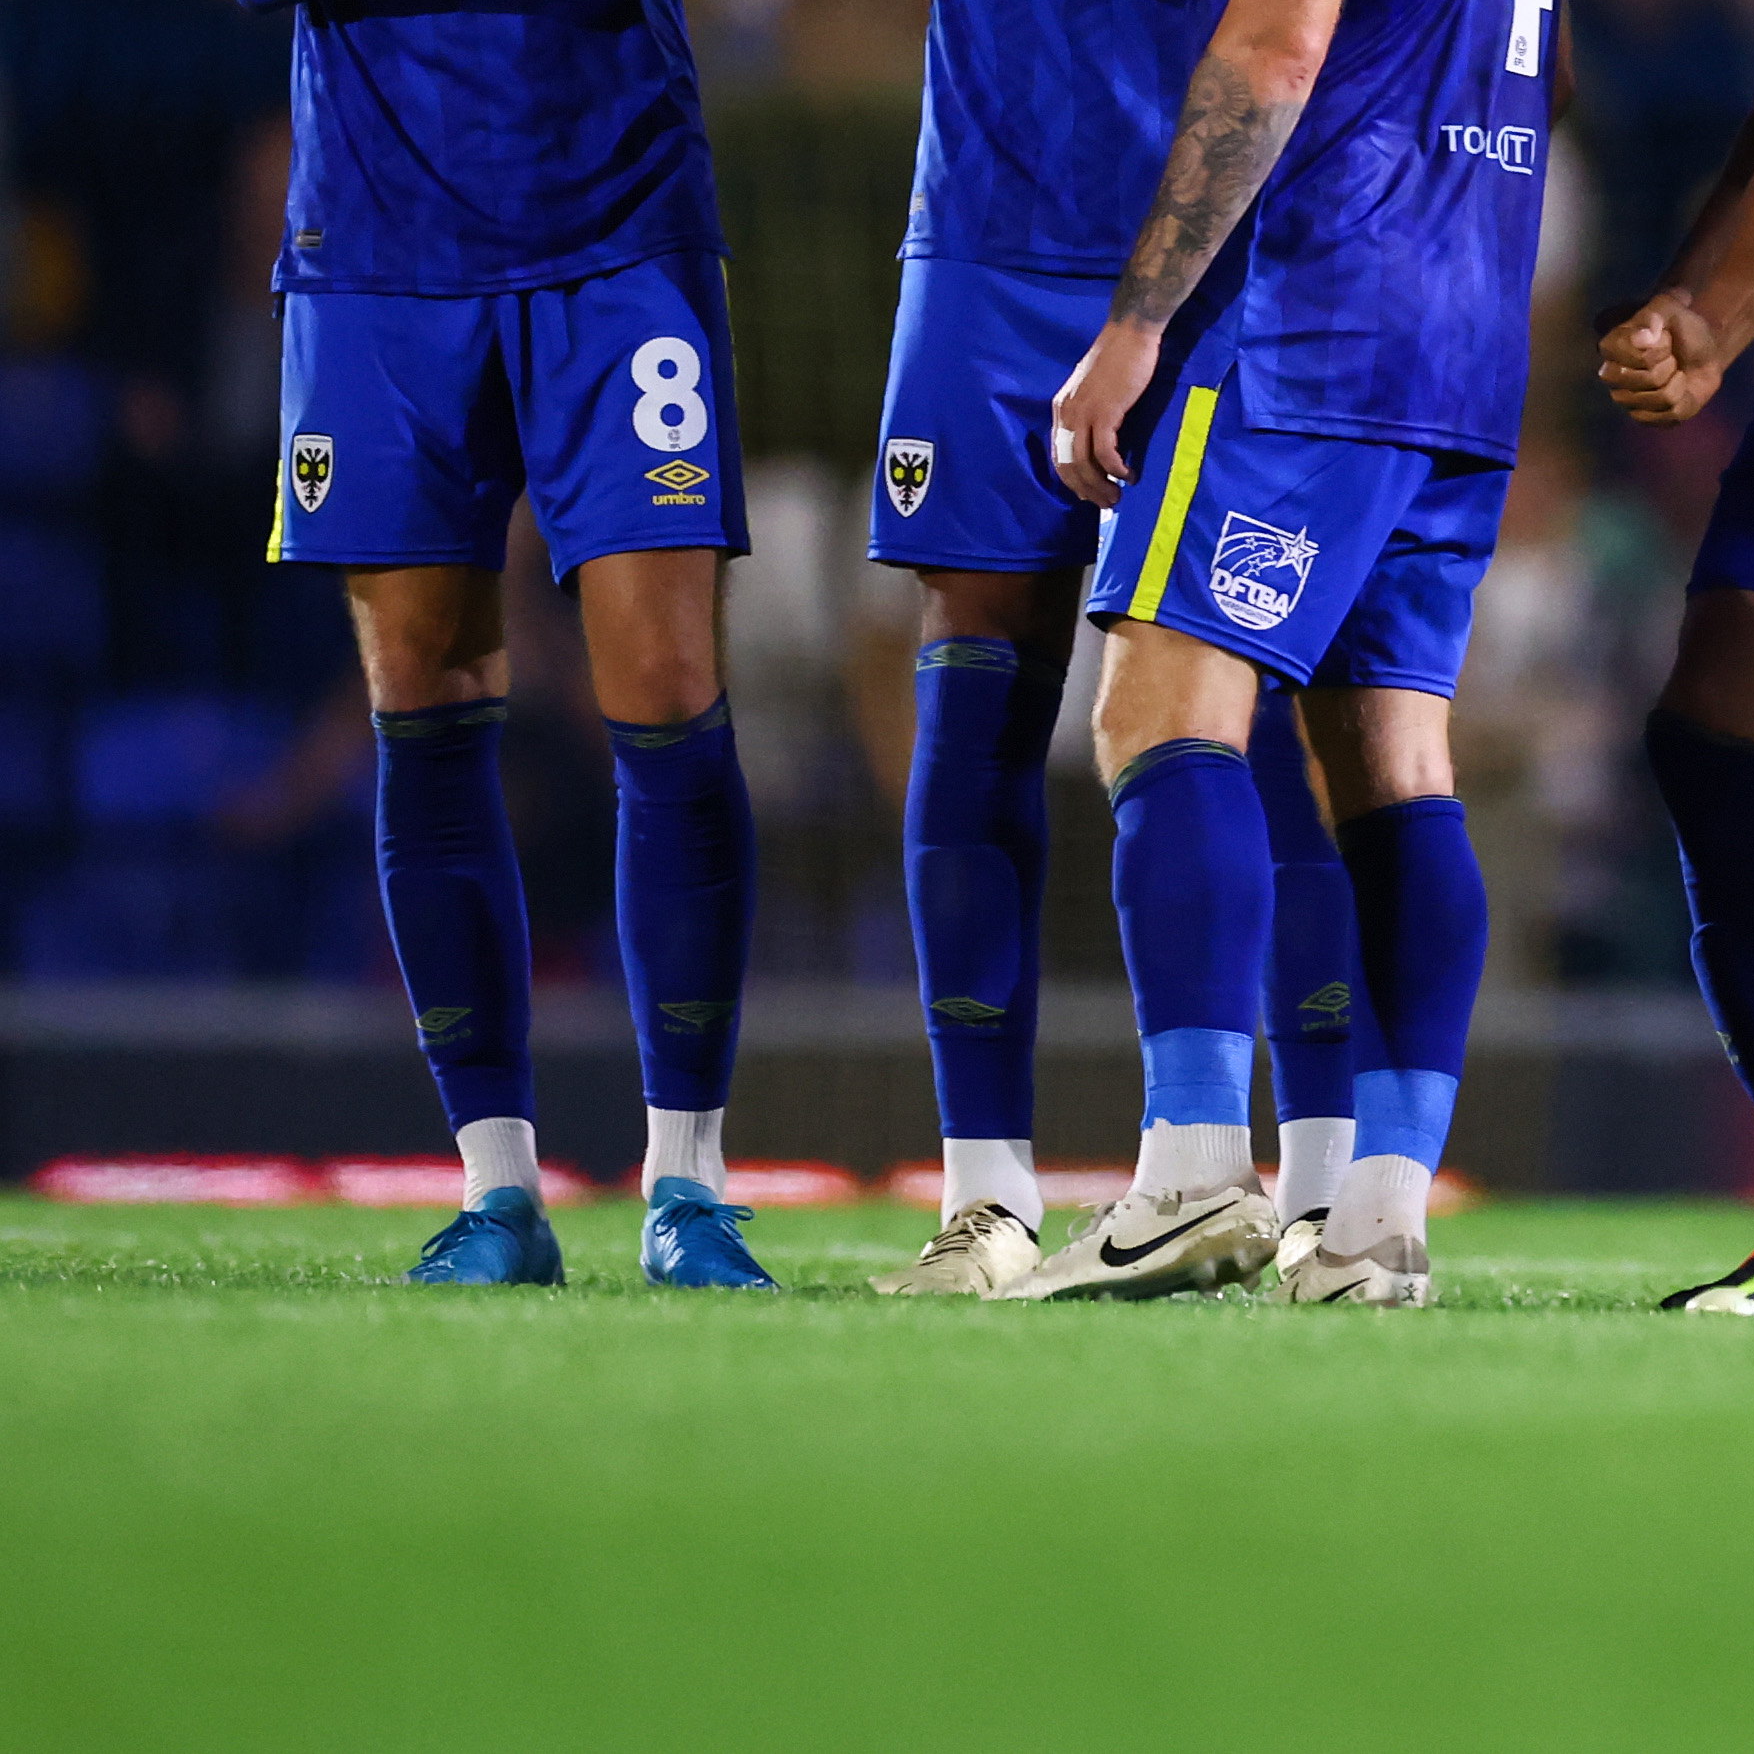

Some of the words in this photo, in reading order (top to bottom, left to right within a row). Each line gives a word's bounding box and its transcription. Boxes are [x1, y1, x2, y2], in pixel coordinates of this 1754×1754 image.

[631, 336, 709, 452] 8
[652, 491, 706, 505] umbro
[1208, 566, 1290, 619] DFTBA
